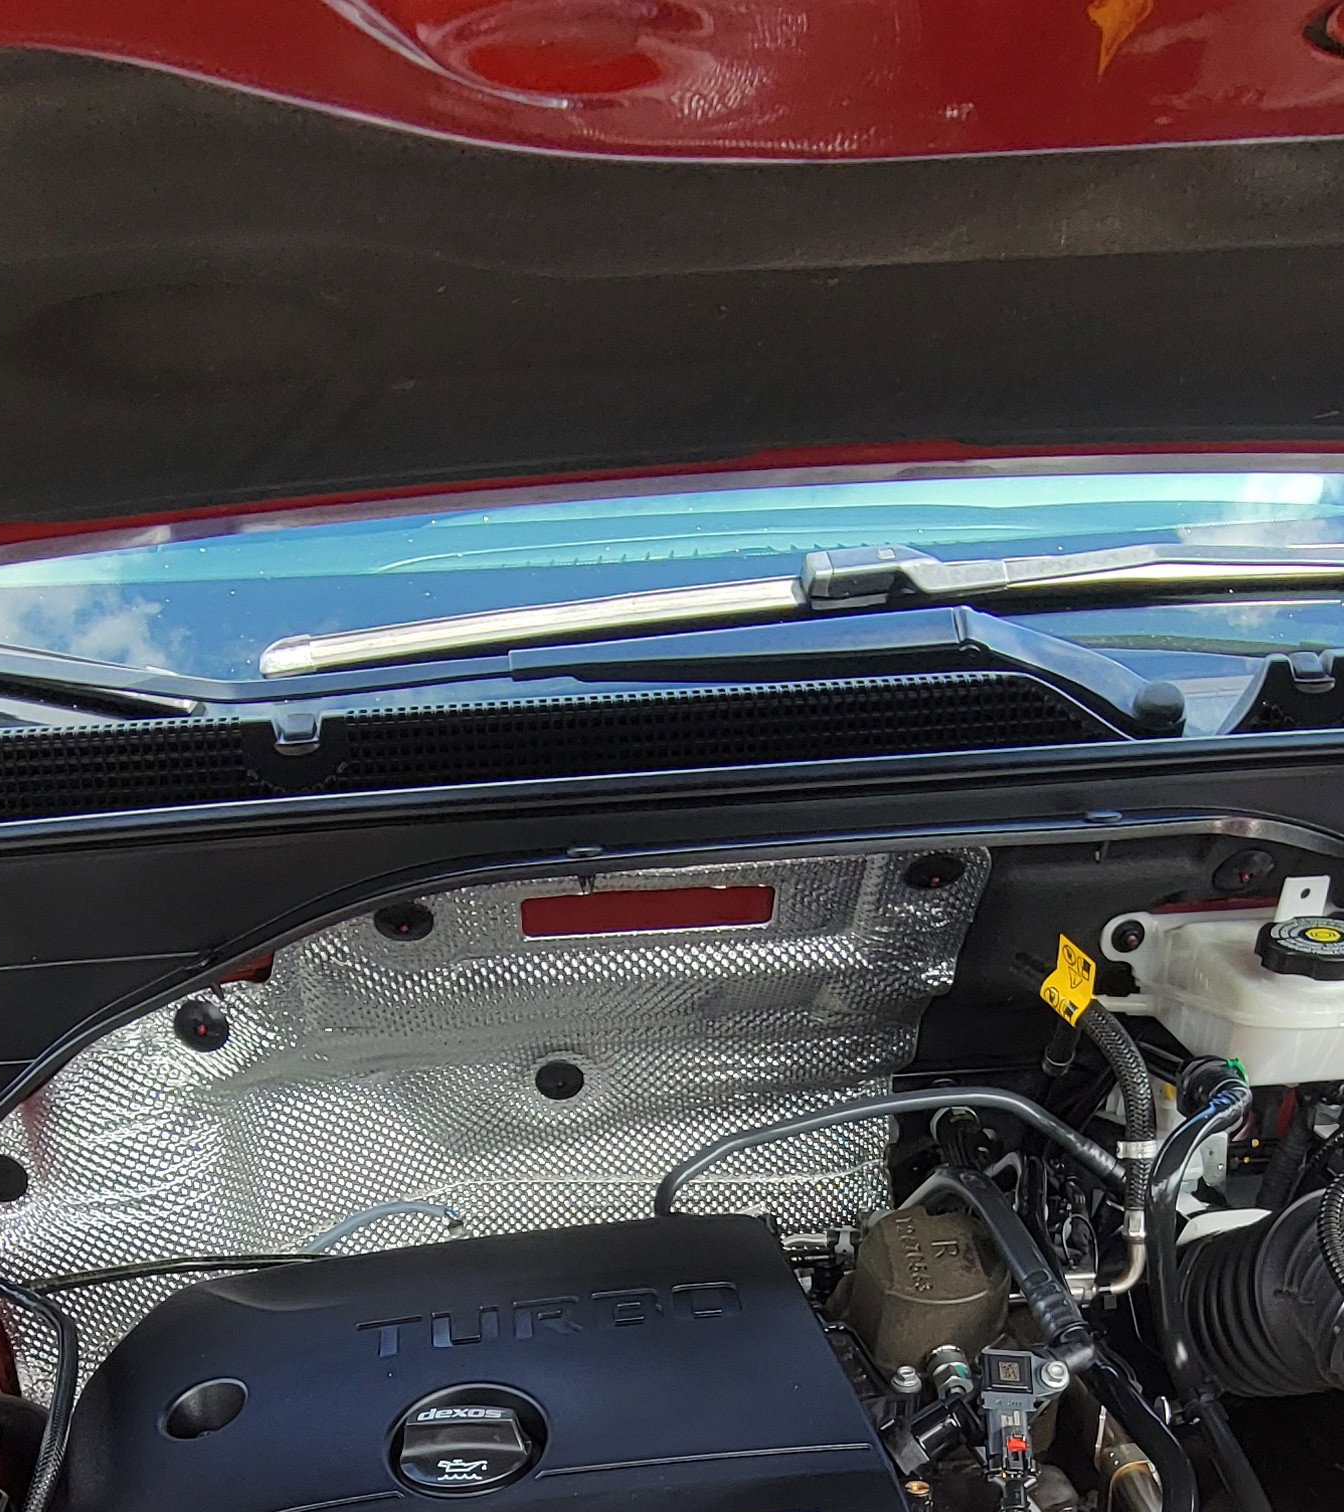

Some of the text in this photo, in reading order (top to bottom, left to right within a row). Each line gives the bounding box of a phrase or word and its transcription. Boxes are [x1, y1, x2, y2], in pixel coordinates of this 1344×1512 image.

[931, 1240, 959, 1258] R
[356, 1281, 742, 1358] TURBO
[417, 1406, 504, 1422] dexos
